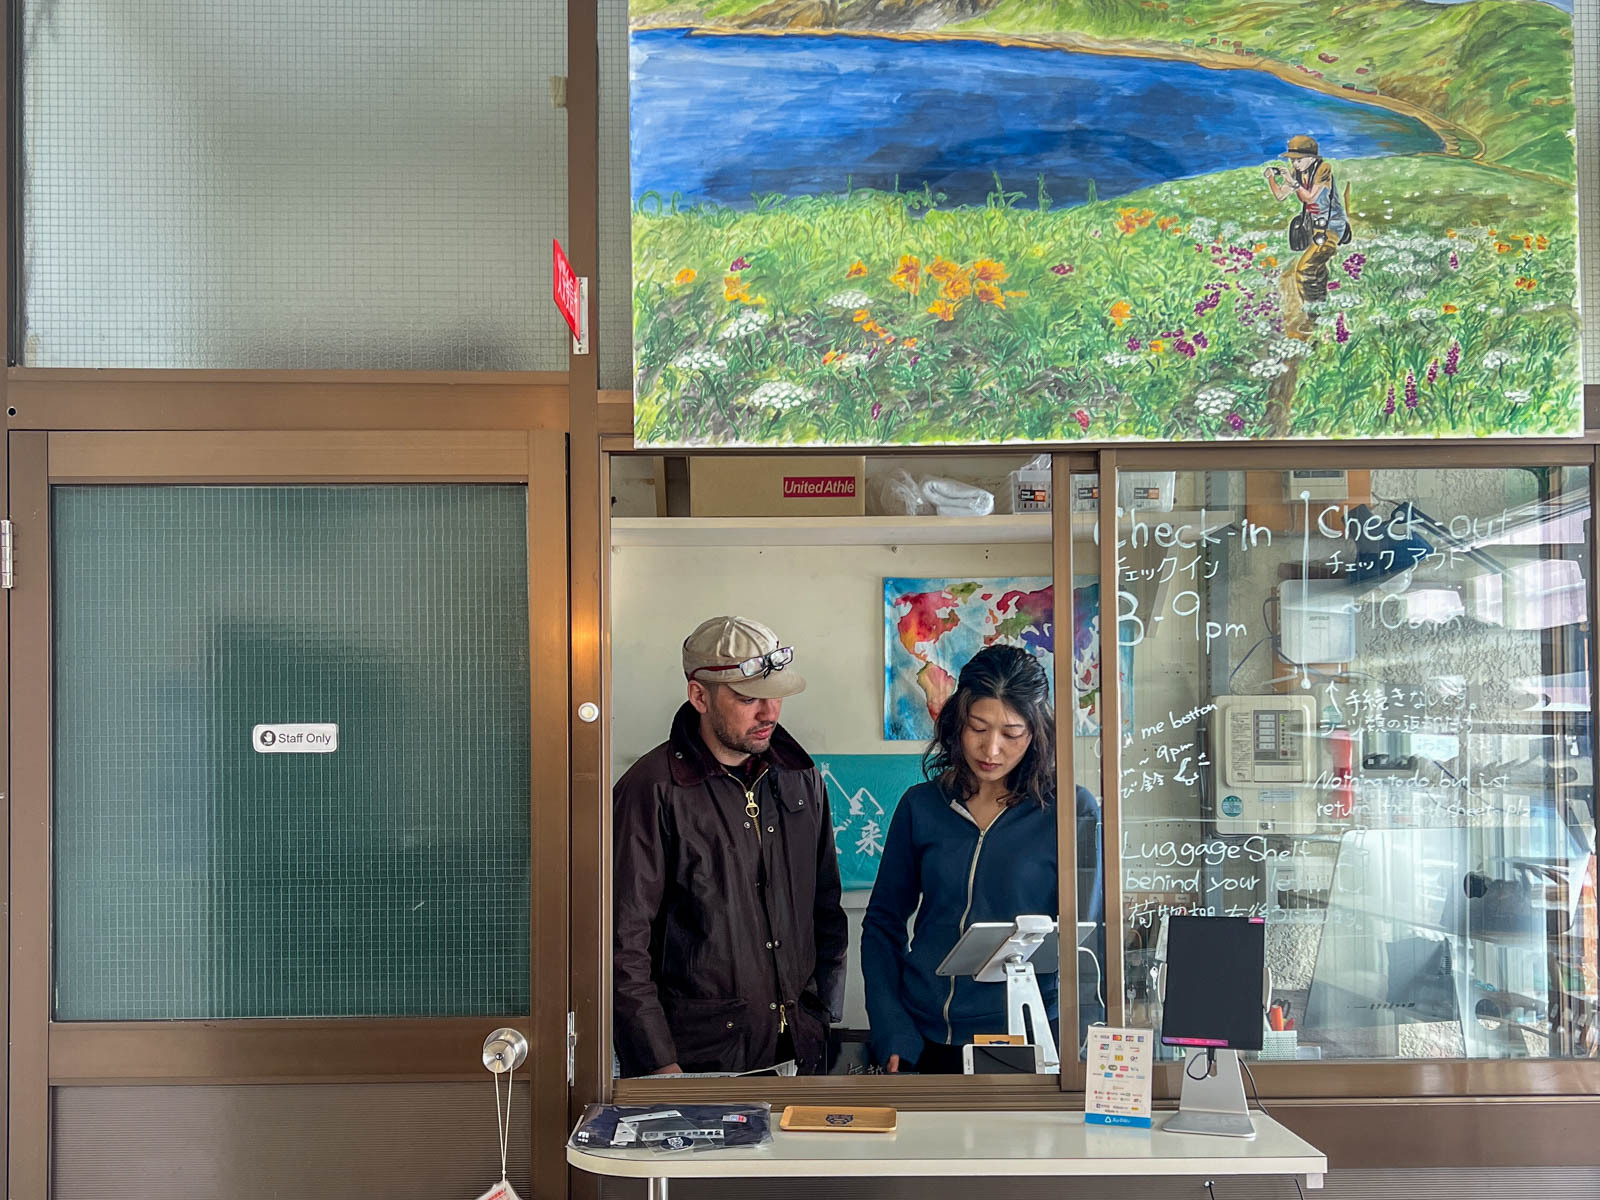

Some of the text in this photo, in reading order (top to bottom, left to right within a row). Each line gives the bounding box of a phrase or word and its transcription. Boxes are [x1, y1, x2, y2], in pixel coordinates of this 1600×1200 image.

[1318, 501, 1513, 545] Check-out
[278, 733, 331, 745] Staff Only
[1141, 722, 1165, 740] me
[1387, 774, 1404, 788] to
[1121, 831, 1312, 867] Luggage Shelf
[1125, 869, 1200, 892] behind
[1206, 875, 1261, 893] your
